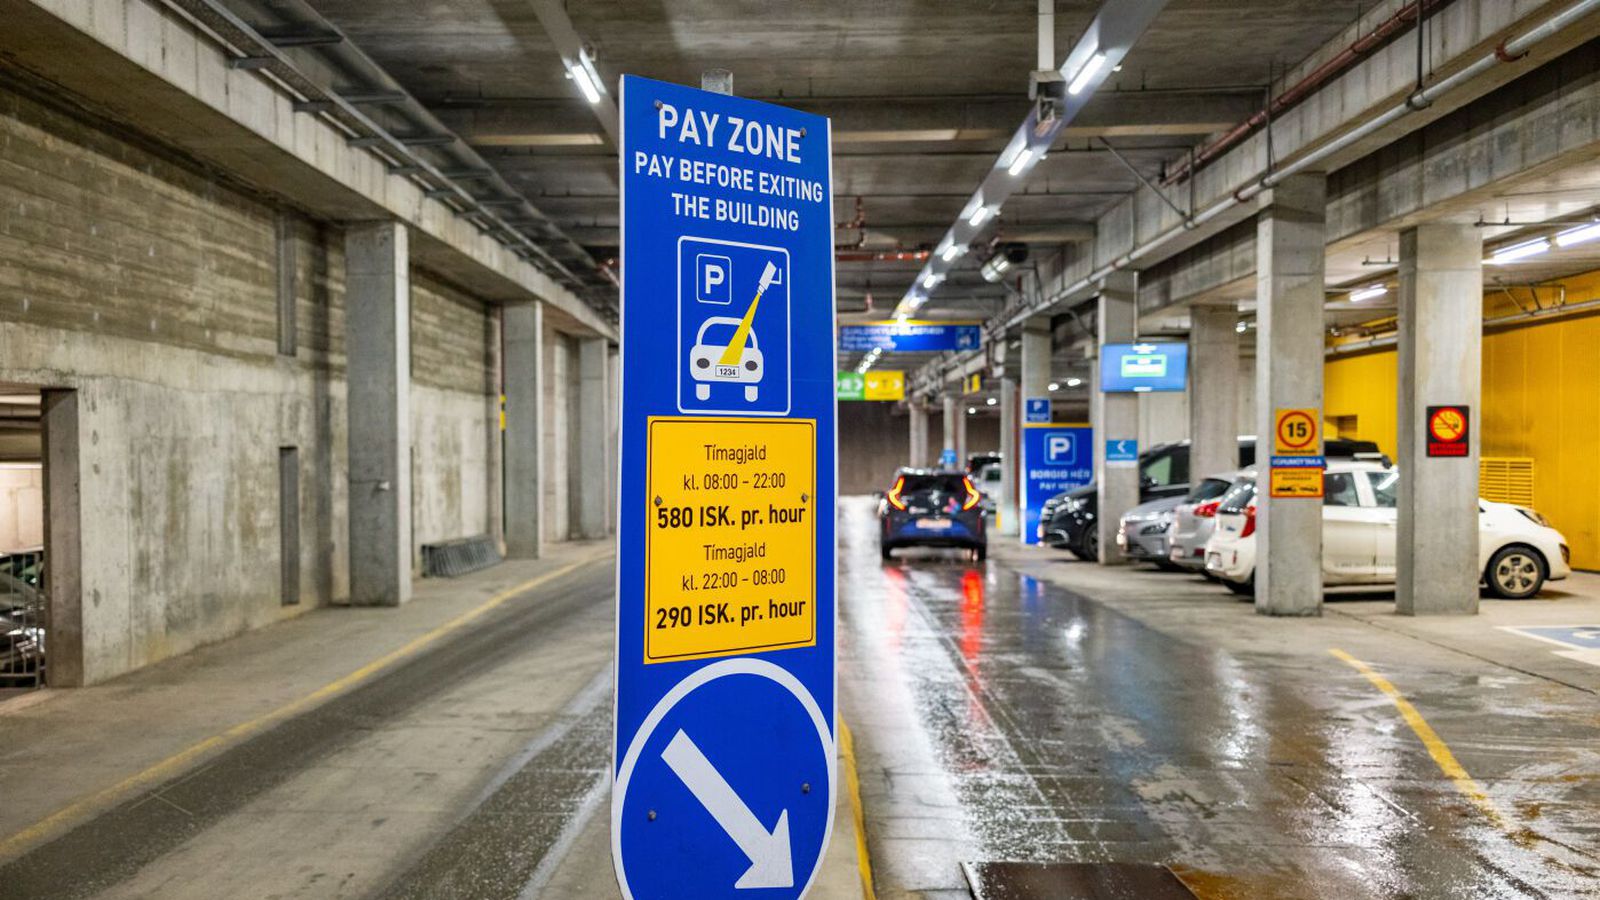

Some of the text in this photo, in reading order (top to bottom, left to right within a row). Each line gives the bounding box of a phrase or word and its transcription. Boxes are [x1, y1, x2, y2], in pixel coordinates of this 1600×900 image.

[659, 104, 802, 163] PAY ZONE
[635, 151, 823, 203] PAY BEFORE EXITING
[671, 192, 799, 231] THE BUILDING
[705, 264, 725, 294] P
[719, 368, 736, 376] 1234
[1286, 422, 1307, 438] 15
[704, 444, 767, 464] Tímagjald
[1049, 437, 1070, 460] P
[683, 474, 699, 490] kl.
[703, 473, 738, 490] 08:00
[753, 472, 786, 489] 22:00
[657, 504, 806, 530] 580 ISK. pr. hour
[703, 542, 766, 563] Tímagjald
[682, 575, 698, 591] kl.
[702, 571, 738, 590] 22:00
[753, 568, 786, 585] 08:00
[656, 599, 806, 629] 290 ISK. pr. hour
